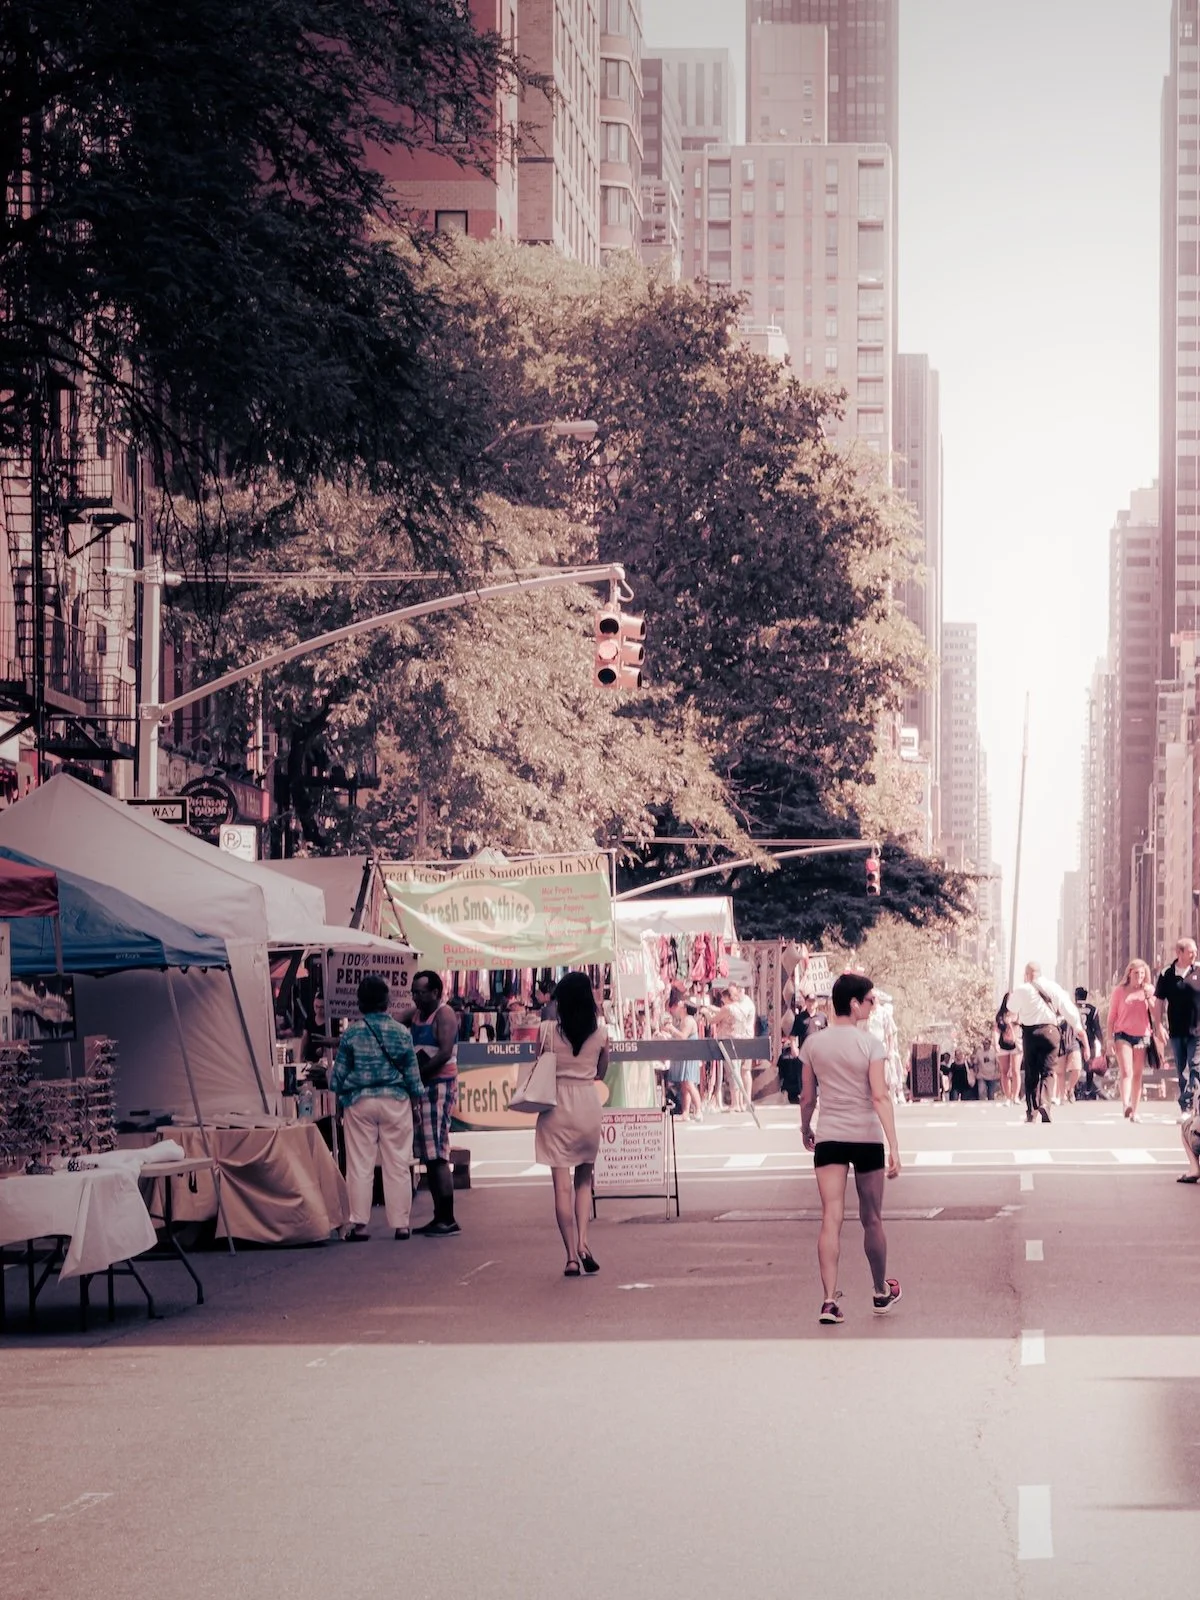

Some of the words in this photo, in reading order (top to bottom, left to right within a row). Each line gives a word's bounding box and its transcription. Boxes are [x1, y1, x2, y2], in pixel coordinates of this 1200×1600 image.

[151, 806, 177, 818] WAY
[384, 870, 408, 882] reat
[489, 858, 555, 879] Smoothies
[559, 859, 573, 874] In
[463, 895, 530, 924] Smoothies
[342, 953, 370, 966] 100%
[372, 954, 405, 965] ORIGINAL
[336, 967, 409, 986] PERMES
[487, 1044, 521, 1054] POLICE
[459, 1082, 498, 1113] Fresh
